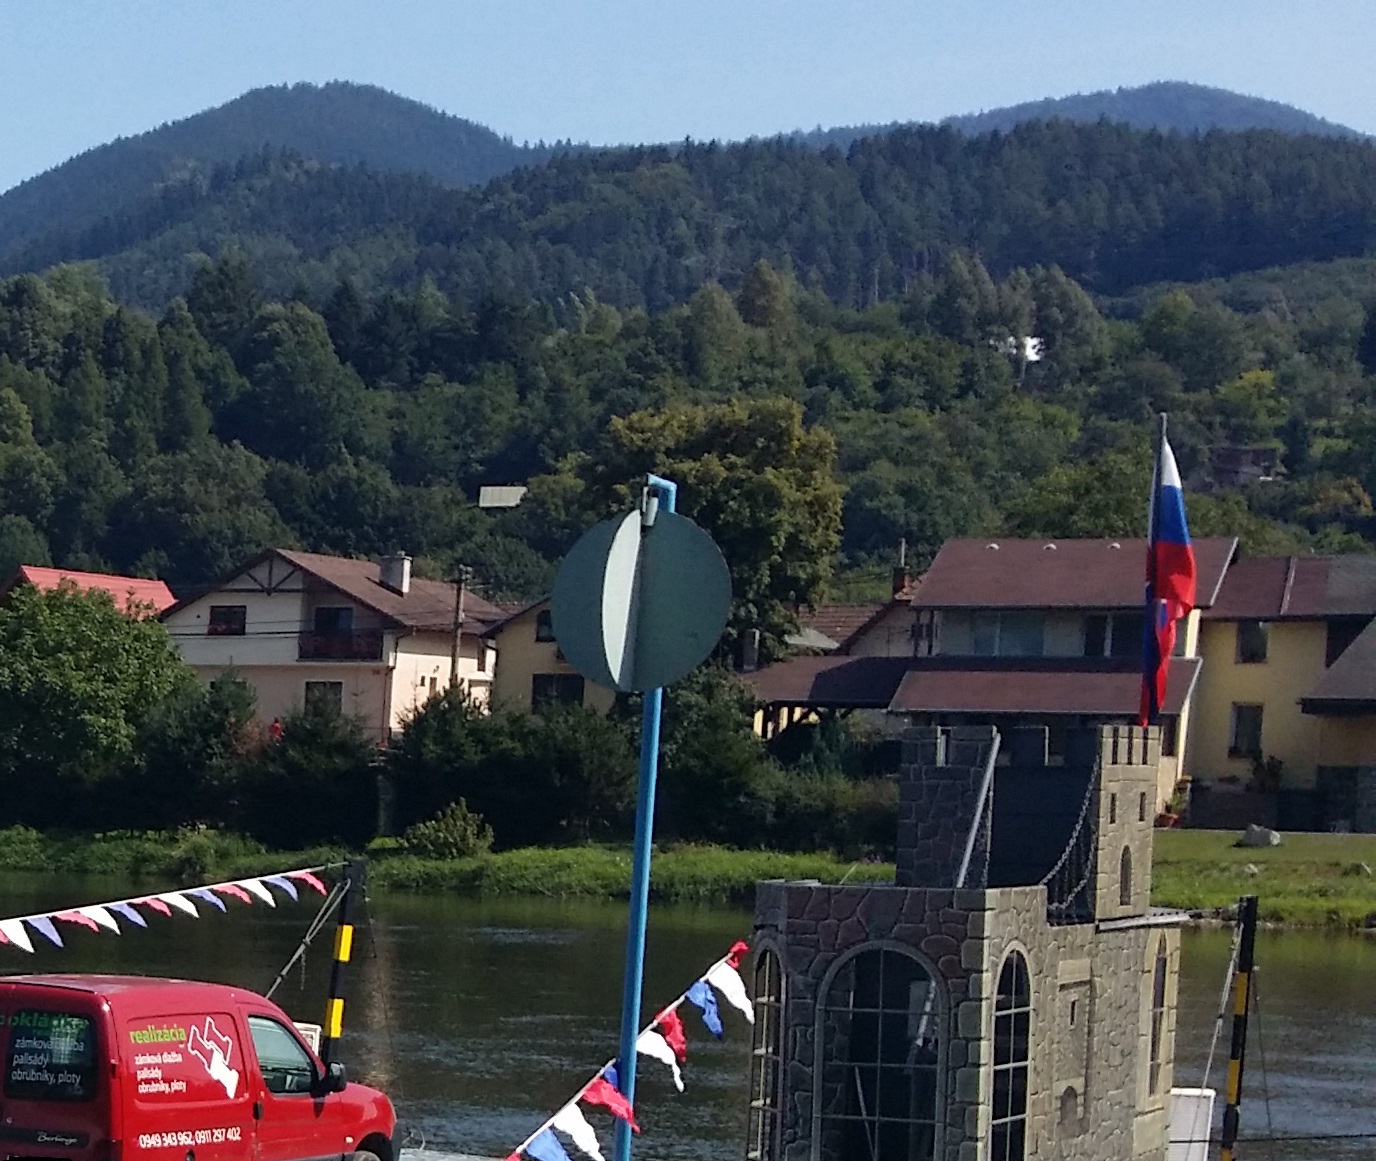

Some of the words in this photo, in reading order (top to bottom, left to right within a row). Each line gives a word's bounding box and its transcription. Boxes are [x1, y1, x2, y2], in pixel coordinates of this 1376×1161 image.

[130, 1024, 186, 1043] realizácia
[139, 1133, 162, 1148] 0949
[161, 1132, 178, 1146] 343
[194, 1129, 212, 1144] 0911
[226, 1126, 241, 1141] 402
